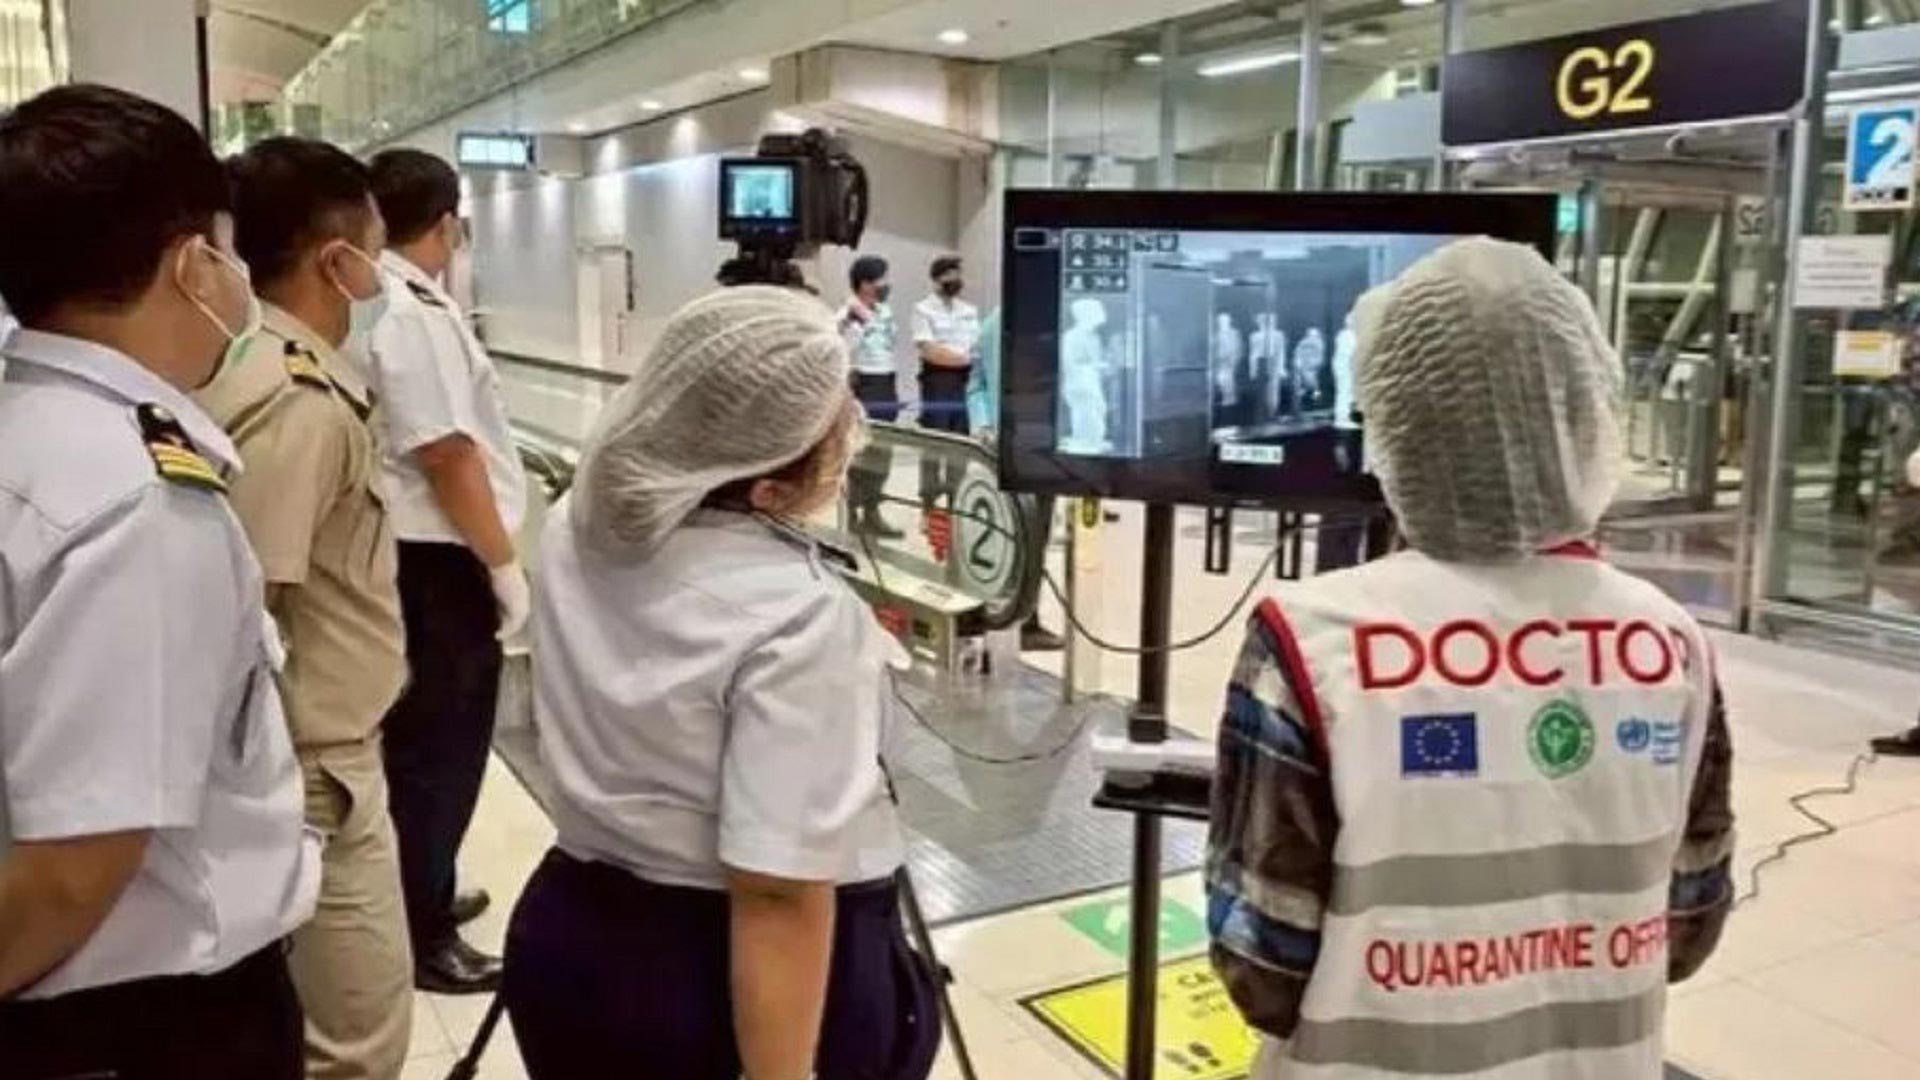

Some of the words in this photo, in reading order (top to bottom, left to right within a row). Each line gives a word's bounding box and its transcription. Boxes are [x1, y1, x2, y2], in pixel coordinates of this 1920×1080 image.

[1556, 38, 1654, 119] G2
[1869, 117, 1914, 186] 2
[968, 498, 996, 570] 2
[1365, 924, 1596, 992] QUARANTINE
